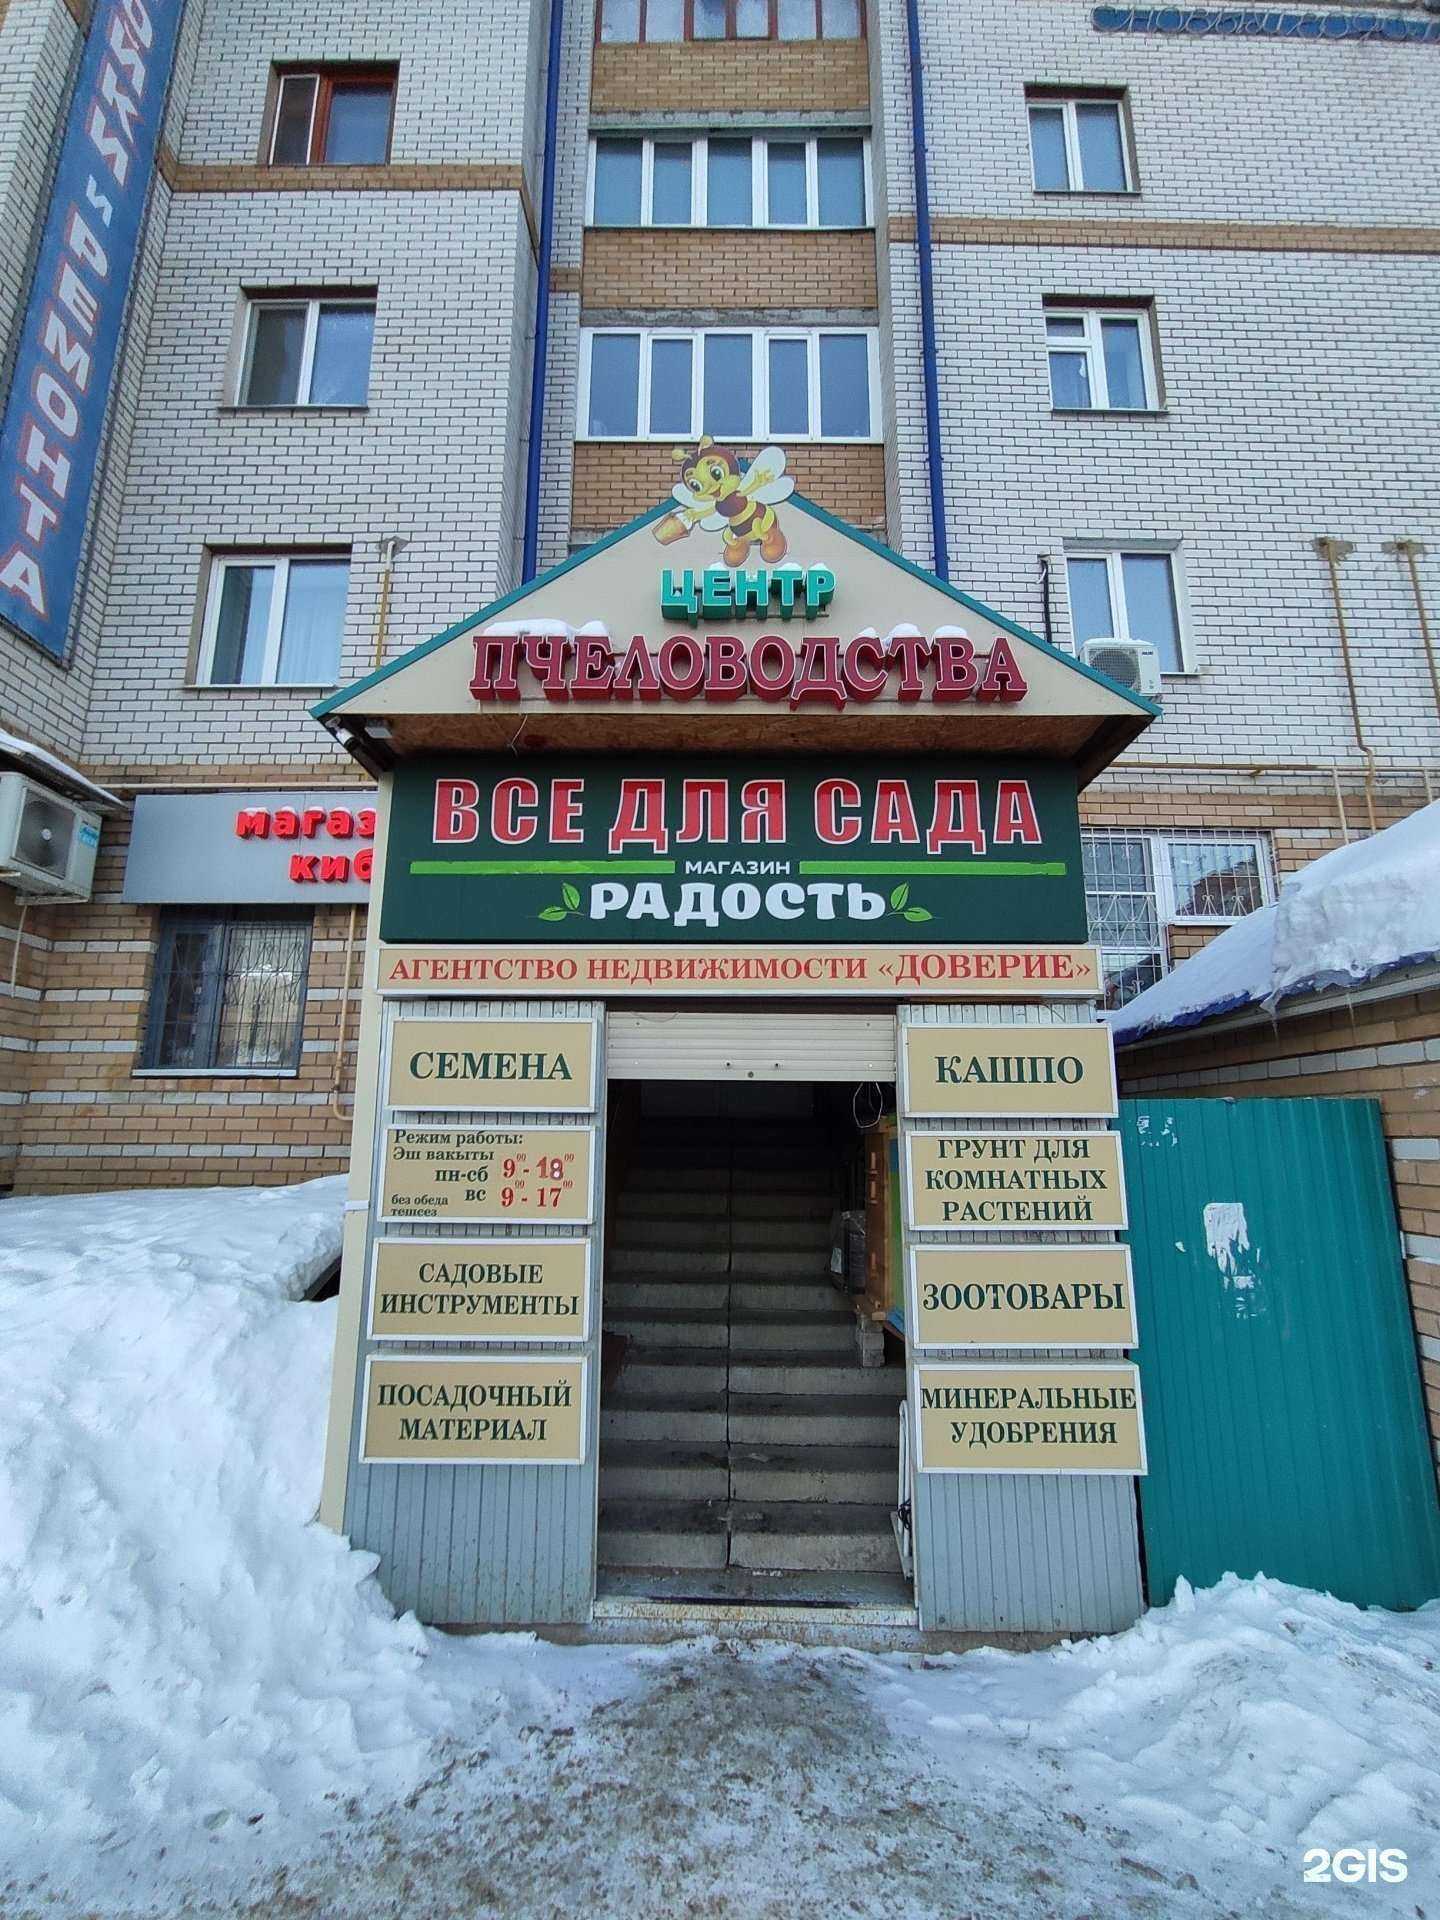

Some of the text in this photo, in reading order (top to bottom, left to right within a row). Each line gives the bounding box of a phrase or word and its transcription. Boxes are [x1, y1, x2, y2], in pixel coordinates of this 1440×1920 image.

[659, 568, 837, 626] ЦЕНТР
[469, 633, 1029, 710] ПЧЕЛОВОДСТВА
[431, 778, 1043, 855] ВСЕ ДЛЯ САДА
[684, 860, 791, 875] МАГАЗИН
[589, 881, 886, 927] РАДОСТЬ
[389, 954, 1091, 985] АГЕНТСТВО НЕДВИЖИМОСТИ «ДОВЕРИЕ»
[409, 1051, 573, 1081] СЕМЕНА
[934, 1055, 1084, 1085] КАШПО
[393, 1129, 524, 1148] Режим работы:
[937, 1139, 1090, 1164] ГРУНТ ДЛЯ
[393, 1146, 495, 1161] Эш вакыты
[434, 1165, 489, 1183] пн-сб
[925, 1169, 1108, 1191] КОМНАТНЫХ
[391, 1193, 449, 1206] без обеда
[464, 1187, 487, 1202] вс
[941, 1195, 1094, 1222] РАСТЕНИЙ
[418, 1262, 543, 1289] САДОВЫЕ
[379, 1293, 580, 1316] ИНСТРУМЕНТЫ
[922, 1282, 1126, 1311] ЗООТОВАРЫ
[377, 1379, 572, 1413] ПОСАДОЧНЫЙ
[920, 1387, 1137, 1410] МИНЕРАЛЬНЫЕ
[398, 1417, 548, 1441] МАТЕРИАЛ
[950, 1421, 1119, 1449] УДОБРЕНИЯ
